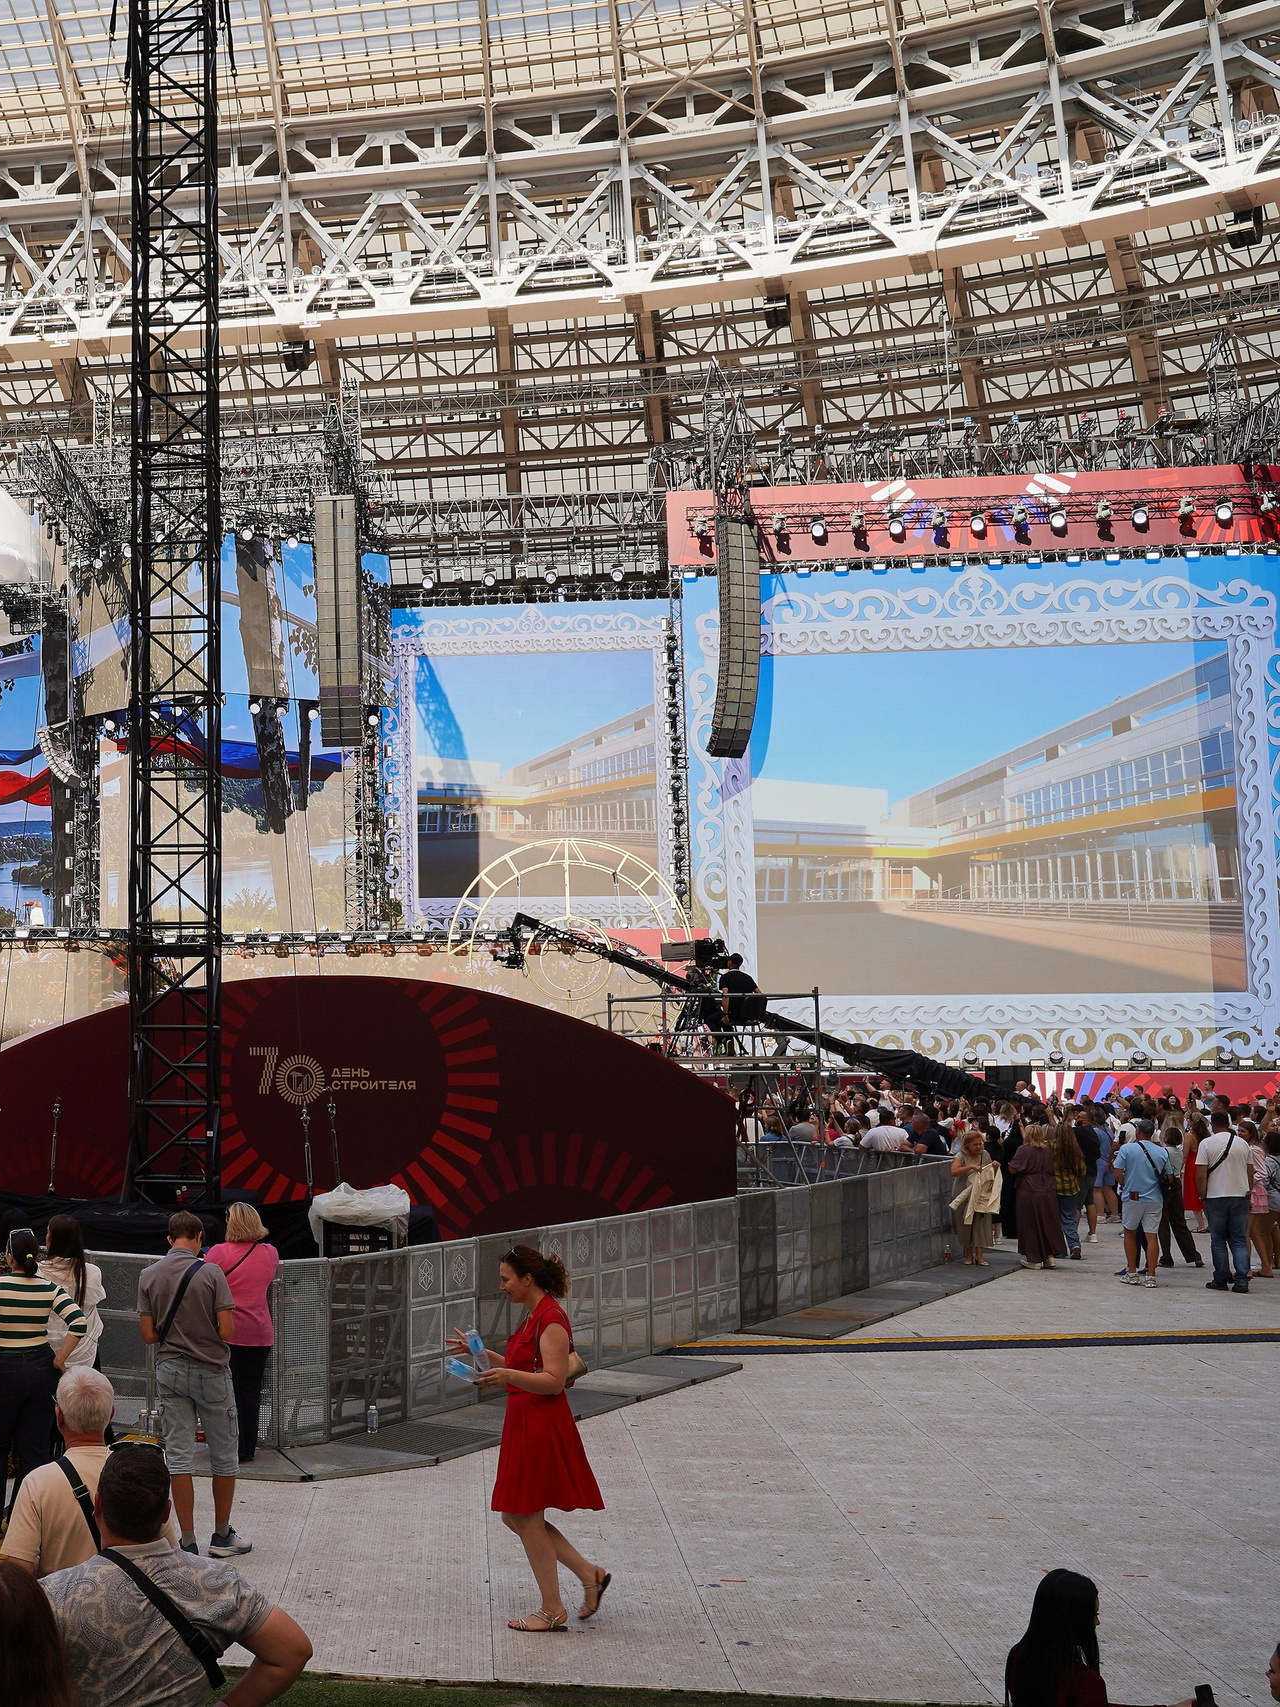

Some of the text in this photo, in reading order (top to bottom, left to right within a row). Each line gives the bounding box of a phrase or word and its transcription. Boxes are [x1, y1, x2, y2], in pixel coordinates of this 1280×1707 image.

[249, 1046, 325, 1105] 70
[331, 1067, 371, 1078] ДЕНЬ
[331, 1080, 417, 1090] СТРОИТЕЛЯ
